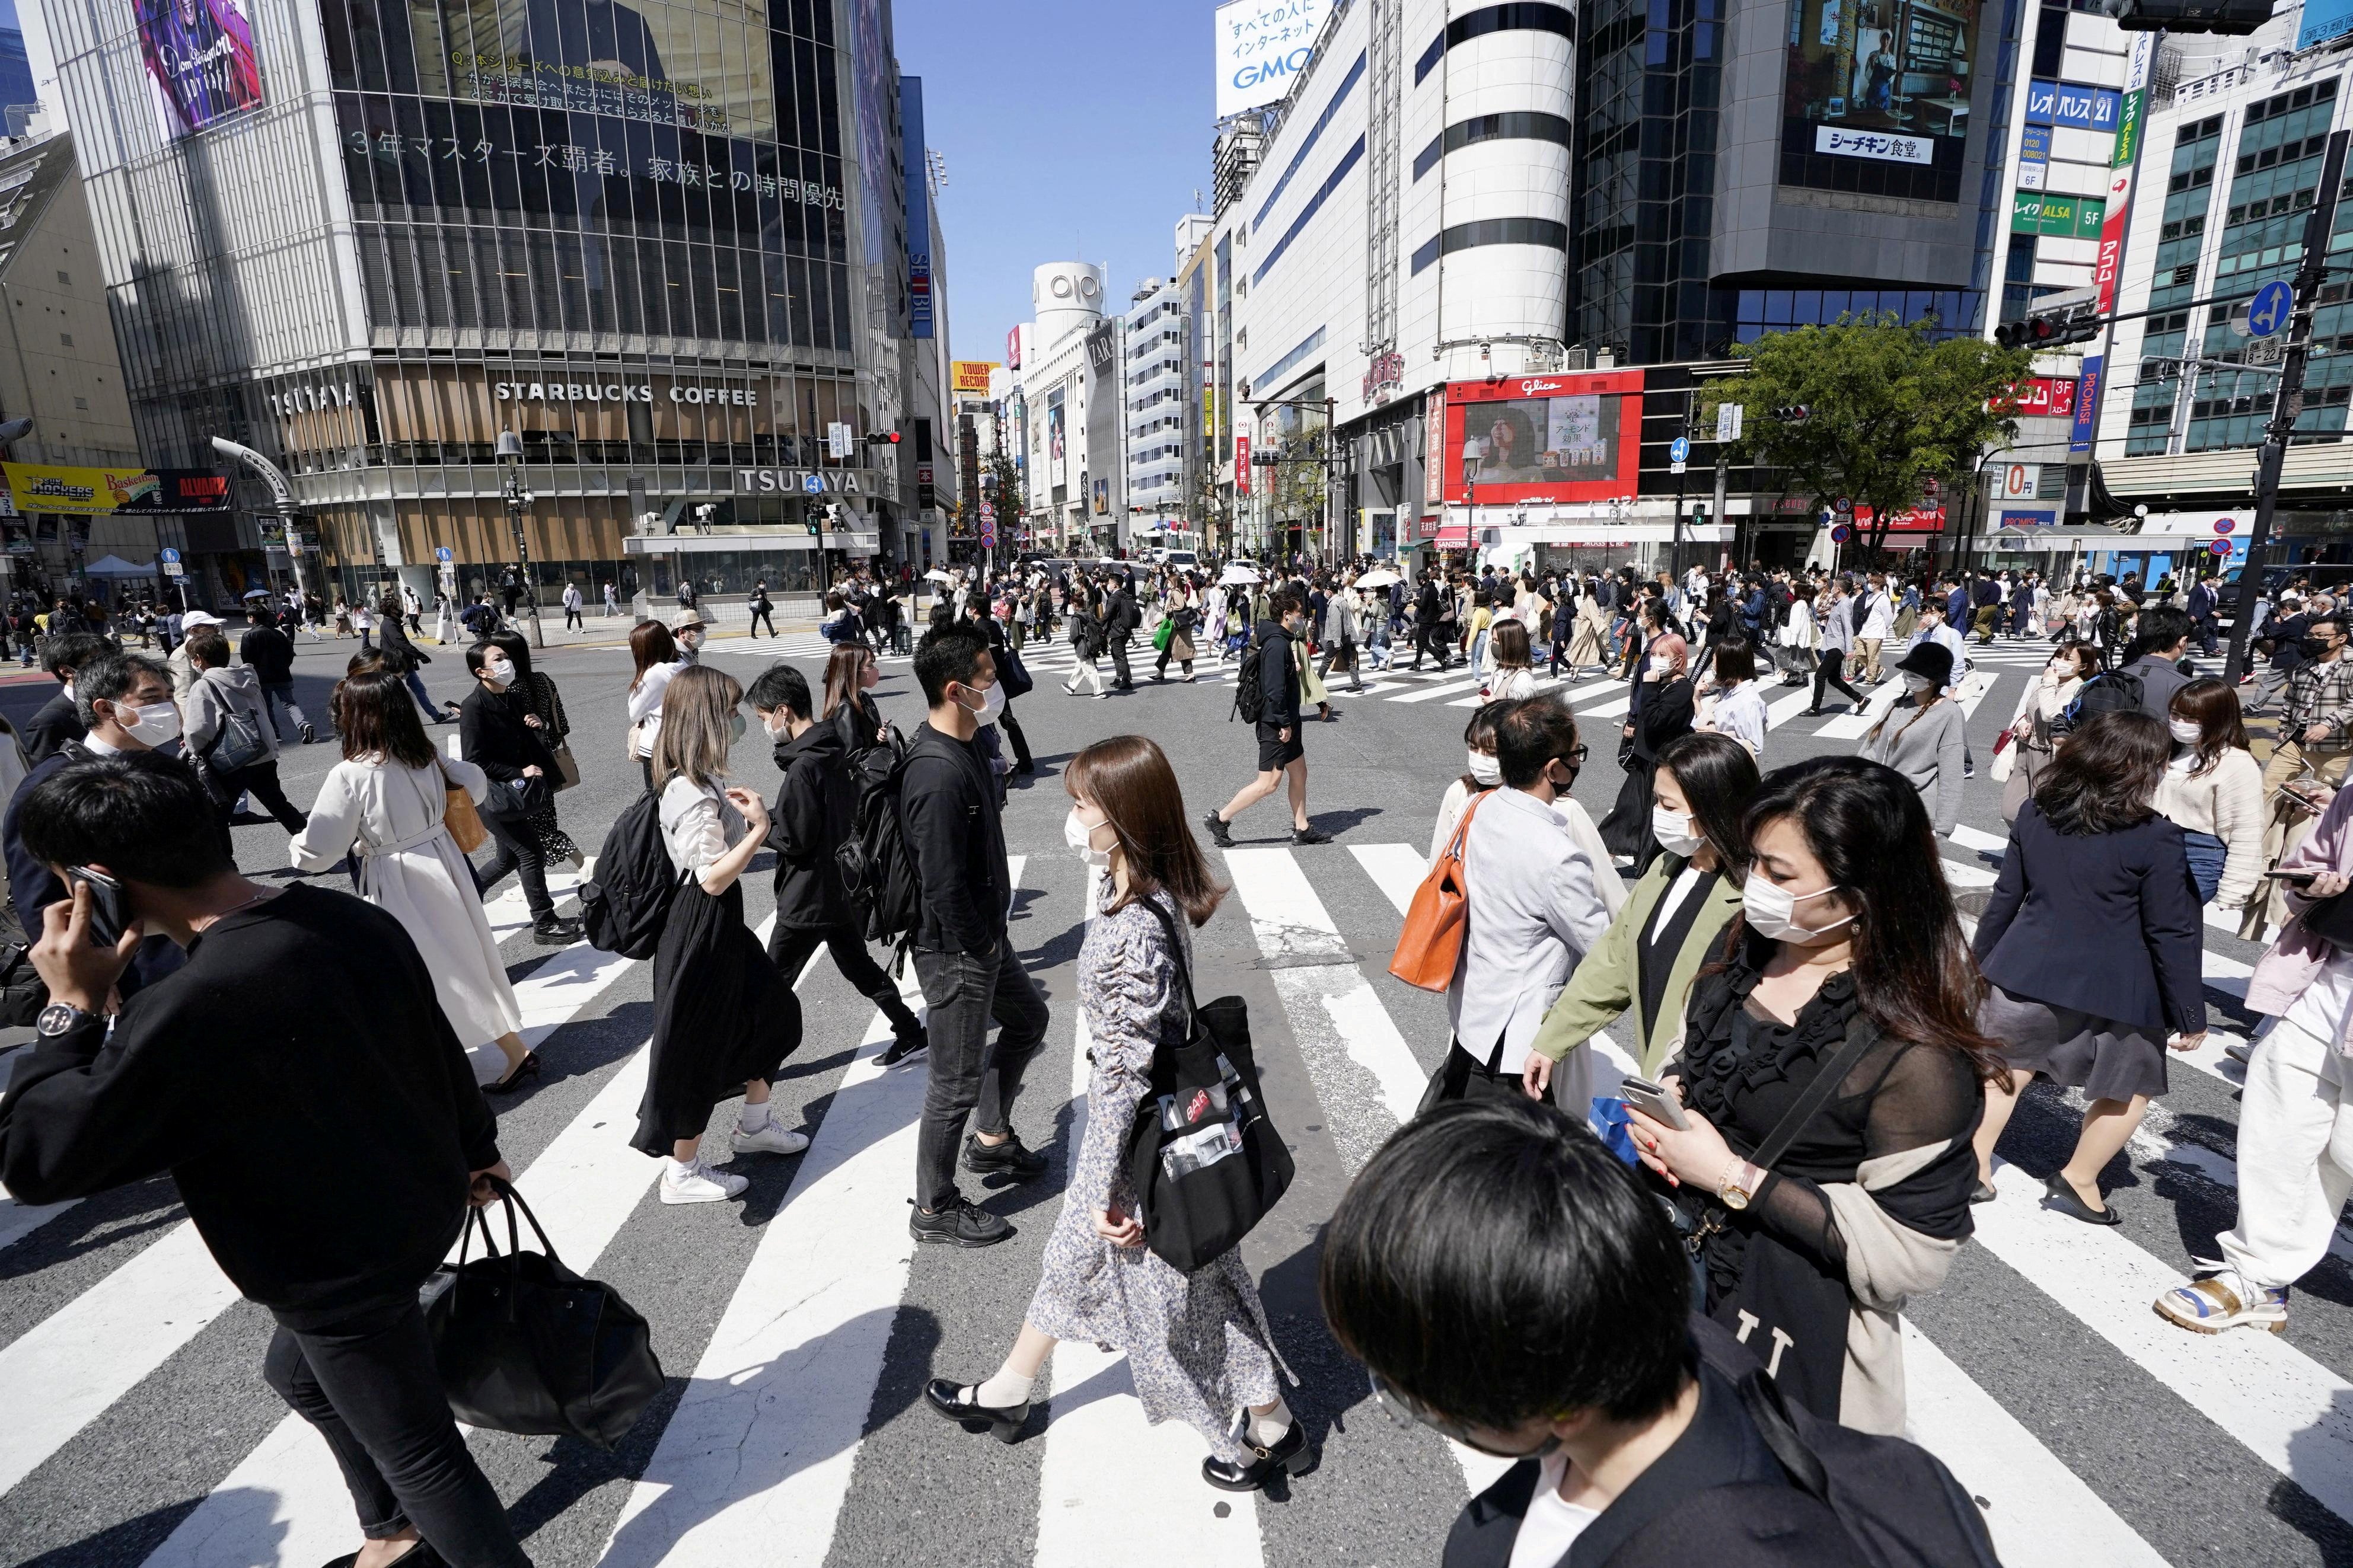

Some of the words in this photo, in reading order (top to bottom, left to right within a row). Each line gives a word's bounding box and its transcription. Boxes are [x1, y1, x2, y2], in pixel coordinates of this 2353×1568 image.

[1233, 0, 1314, 39] すべての人に
[1233, 18, 1314, 58] インターネット
[160, 44, 192, 78] Dom
[1233, 47, 1315, 89] GMO
[2125, 94, 2138, 122] レイク
[2025, 128, 2049, 137] フリーコール
[1829, 133, 1917, 158] シーチキン食堂
[2024, 139, 2040, 148] 0120
[2119, 122, 2132, 161] ALSA
[2023, 149, 2045, 160] 008021
[2020, 165, 2044, 173] お部屋探しは
[2025, 175, 2036, 185] 6F
[2014, 202, 2040, 215] レイク
[2042, 205, 2071, 219] ALSA
[2084, 211, 2099, 225] 5F
[2098, 240, 2118, 282] アコム
[910, 253, 930, 321] SEIBU
[1089, 334, 1114, 367] ZARA
[2249, 337, 2279, 352] 路線バスを除く
[962, 363, 990, 375] TOWER
[495, 382, 653, 402] STARBUCKS
[669, 386, 757, 406] COFFEE
[1522, 379, 1562, 396] Glico
[2055, 381, 2072, 394] 3F
[2078, 373, 2097, 424] PROMISE
[1556, 424, 1590, 434] アーモンド
[1722, 407, 1731, 439] 渋谷駅前
[1562, 434, 1582, 443] 効果
[1430, 411, 1440, 498] 天津甘栗
[104, 474, 159, 491] Basketball
[920, 471, 930, 481] 本
[28, 475, 95, 497] ROCKERS
[2, 499, 12, 516] ココカ
[1421, 522, 1437, 532] 天津甘栗
[1186, 1089, 1208, 1122] BAR
